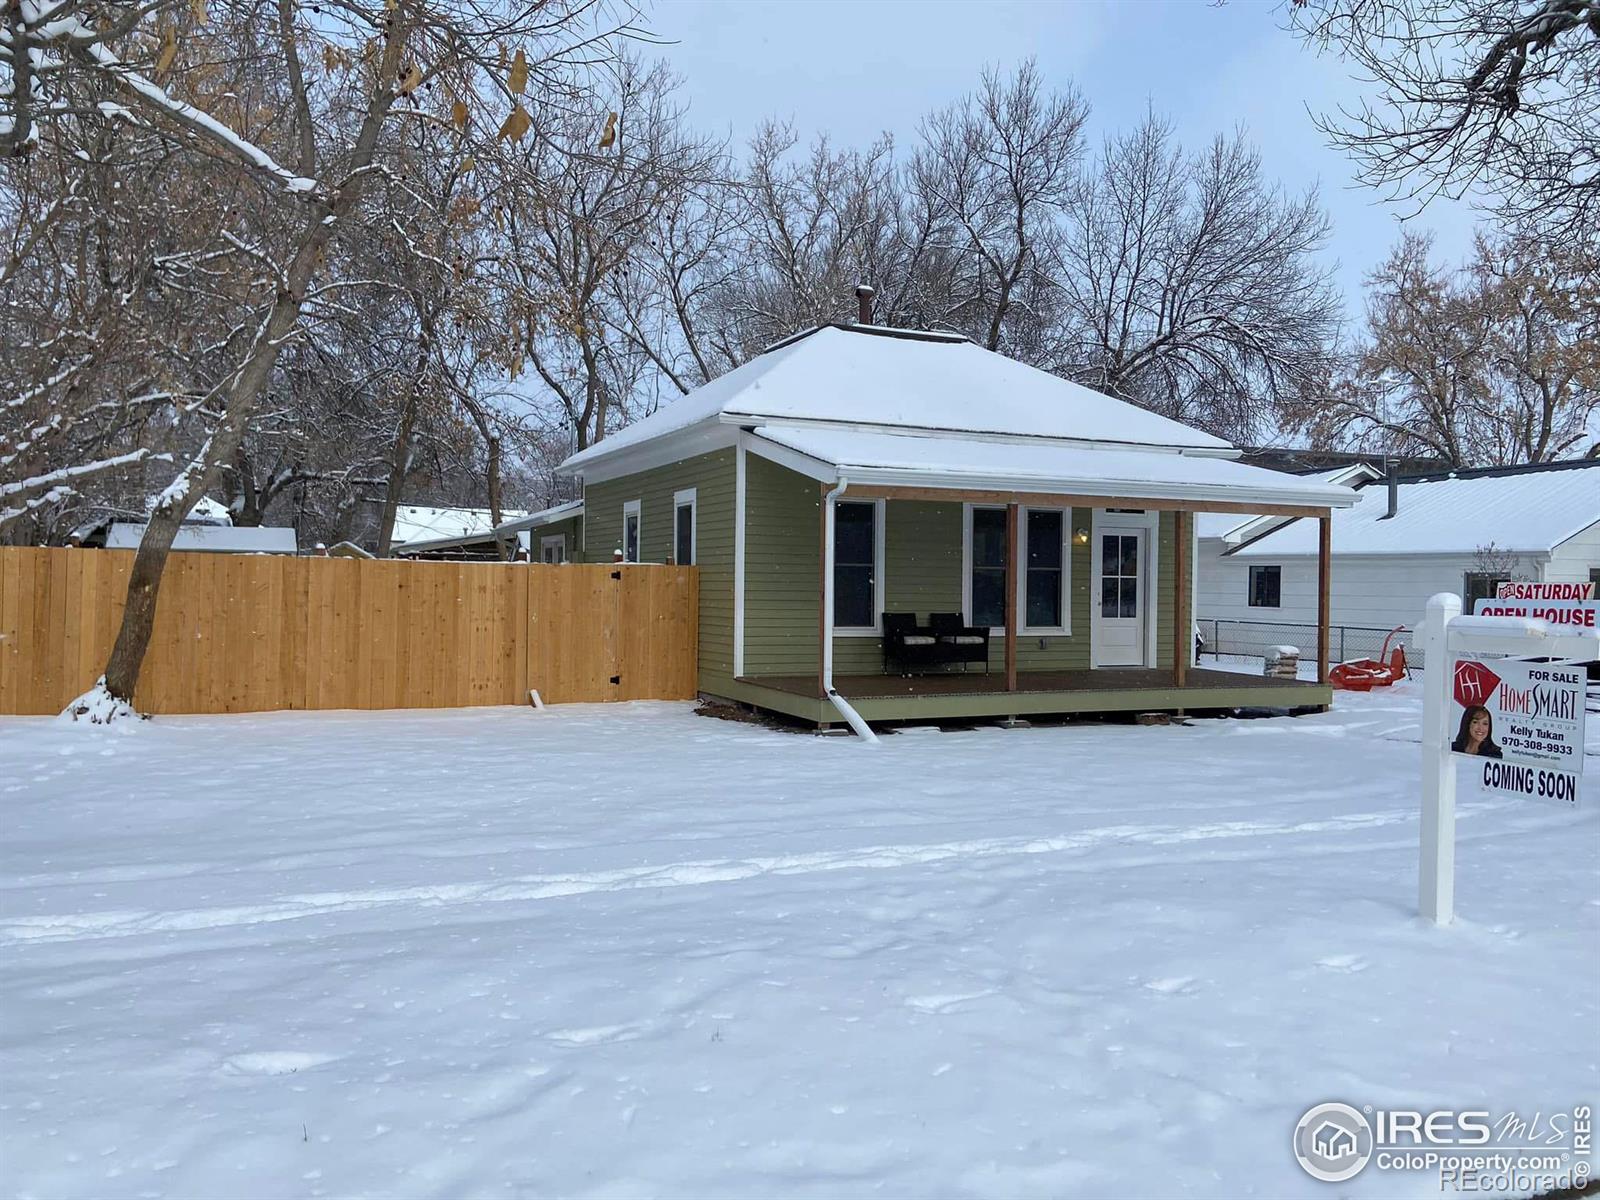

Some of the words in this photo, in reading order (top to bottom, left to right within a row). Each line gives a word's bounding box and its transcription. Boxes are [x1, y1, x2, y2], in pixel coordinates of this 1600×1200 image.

[1515, 583, 1592, 600] SATURDAY
[1533, 608, 1596, 627] HOUSE
[1529, 670, 1549, 681] FOR
[1552, 673, 1579, 684] SALE
[1510, 725, 1533, 738] Kelly
[1535, 728, 1564, 741] Tukan
[1501, 736, 1573, 755] 970-308-9933
[1483, 761, 1534, 794] COMING
[1537, 770, 1576, 802] SOON
